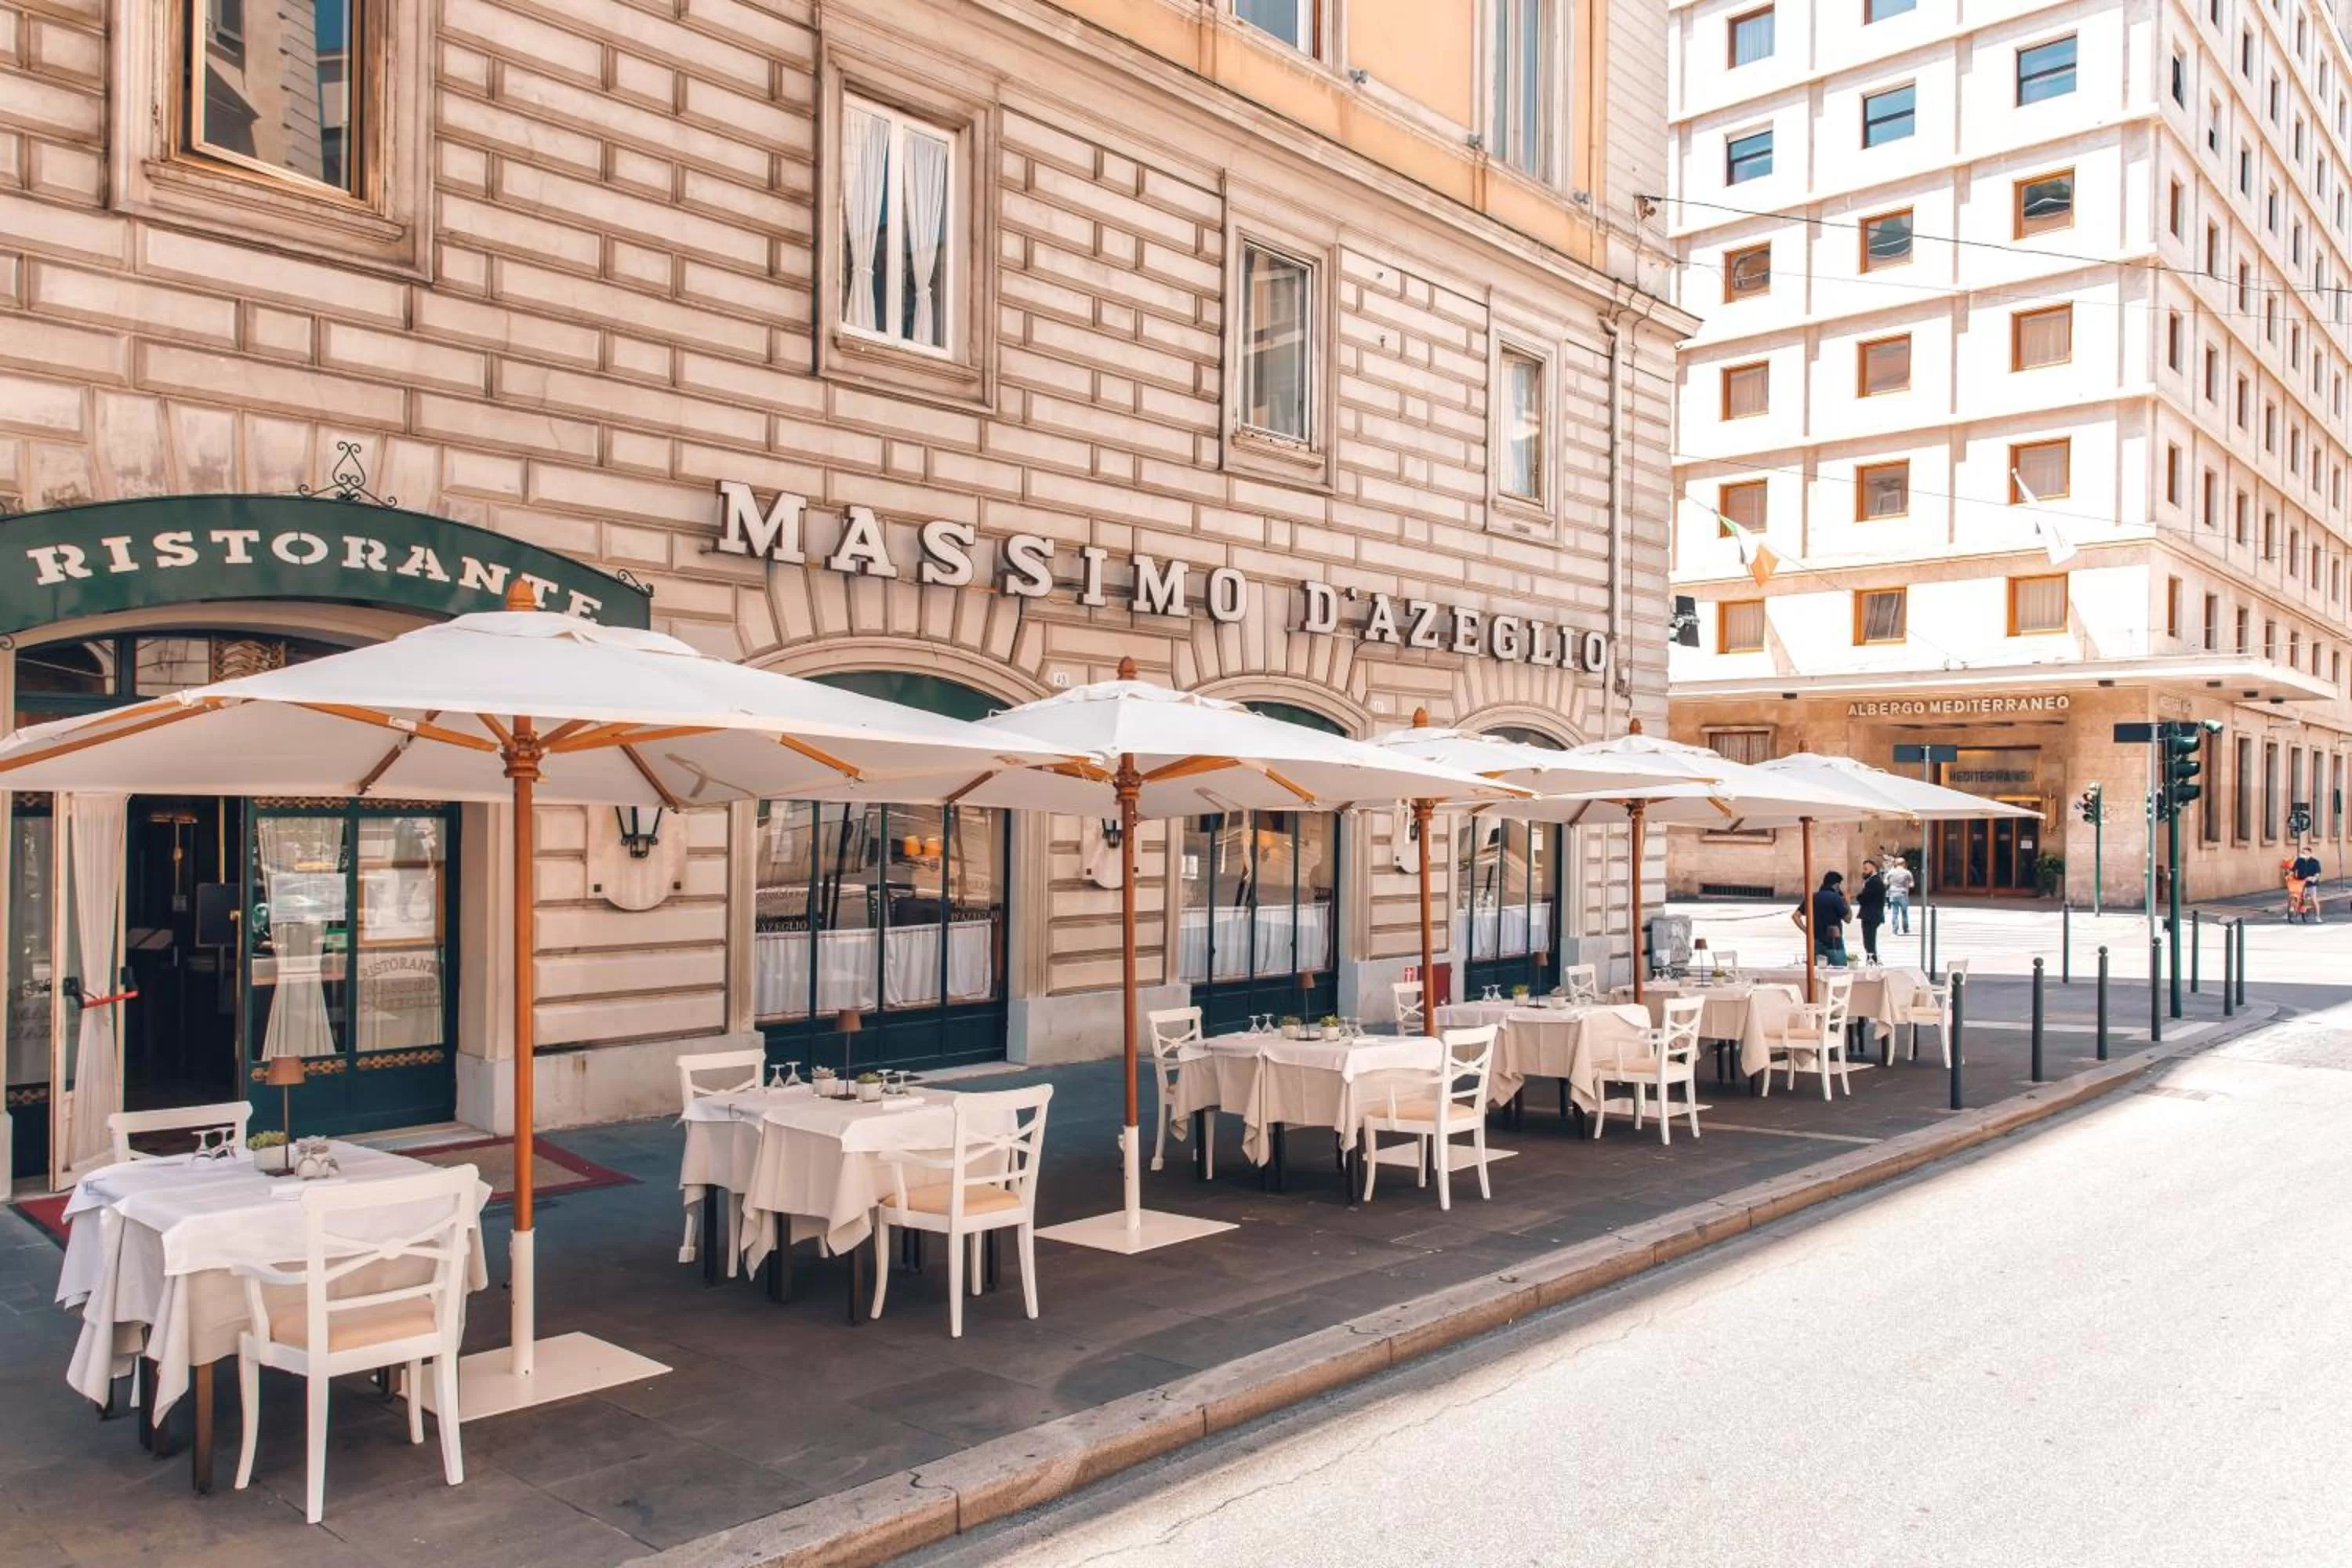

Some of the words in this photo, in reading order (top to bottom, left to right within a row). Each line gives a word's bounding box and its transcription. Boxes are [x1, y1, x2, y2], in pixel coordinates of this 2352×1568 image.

[26, 529, 603, 624] RISTORANTE
[715, 479, 1248, 625] MASSIMO
[1300, 579, 1608, 673] D'AZEGLIO
[1847, 700, 1925, 717] ALBERGO
[1929, 695, 2070, 713] MEDITERRANEO
